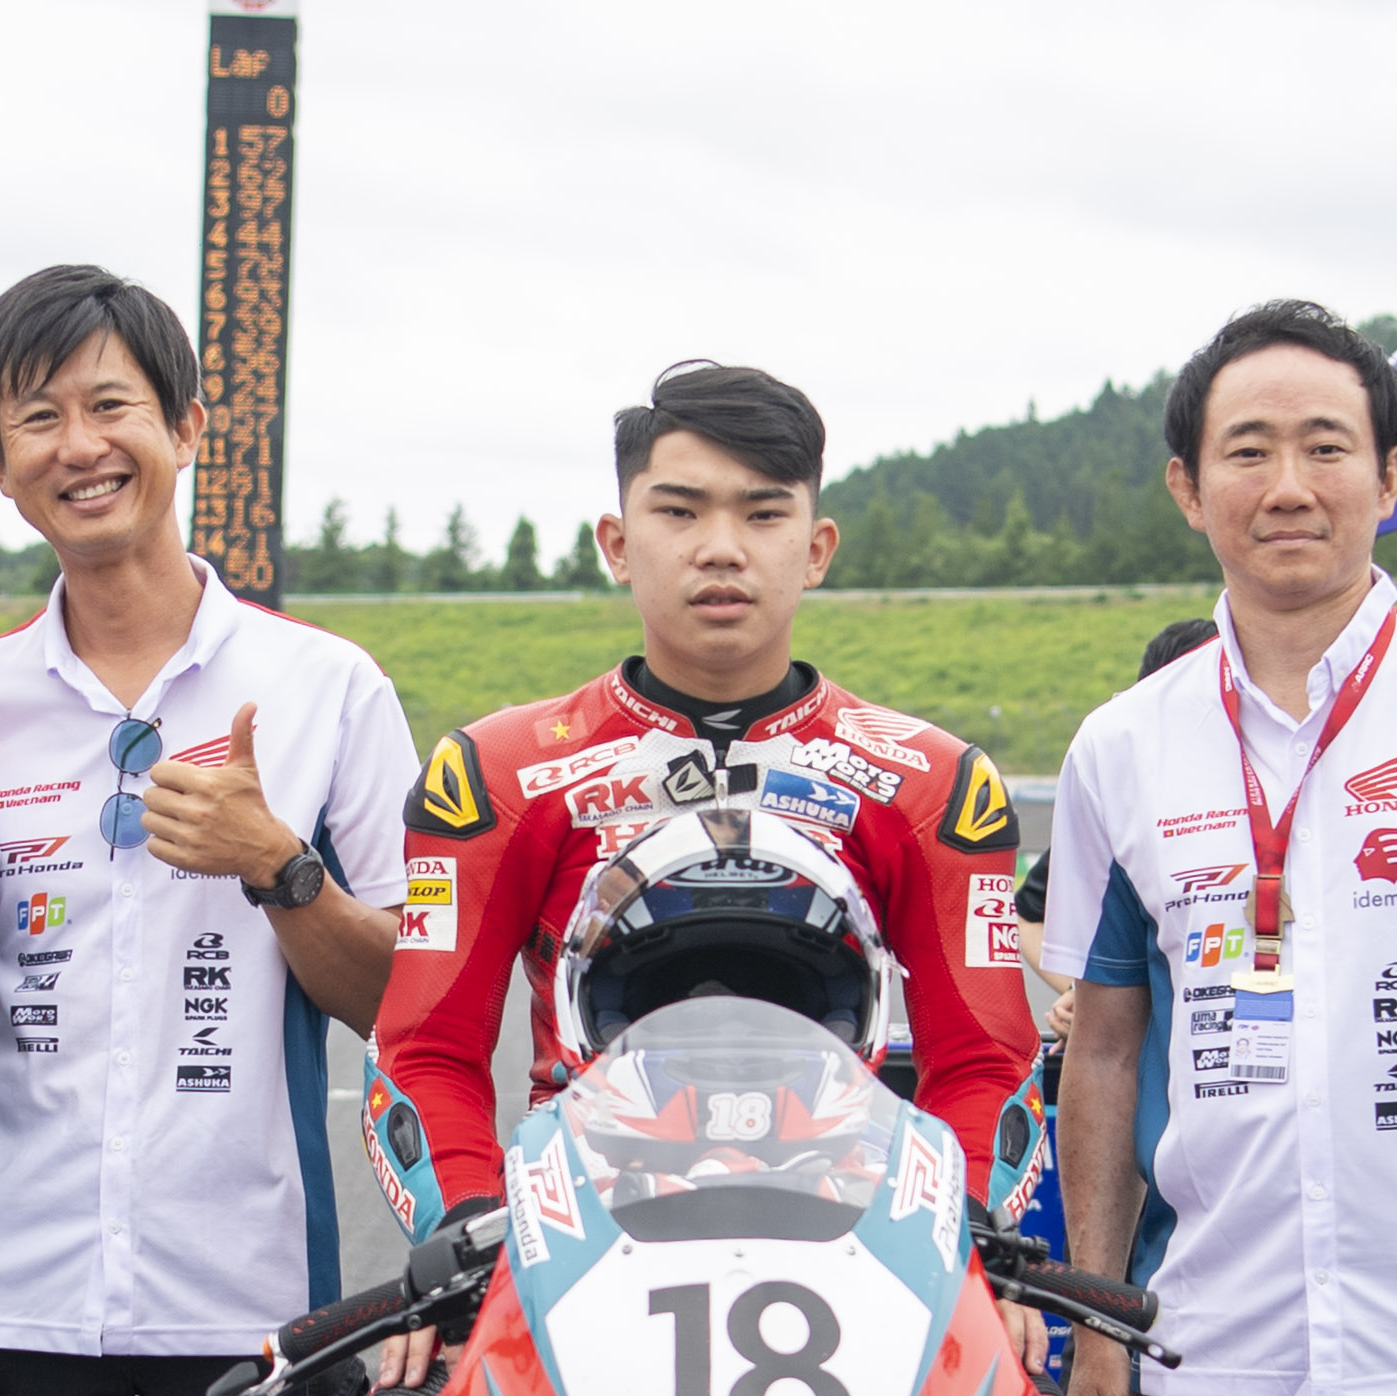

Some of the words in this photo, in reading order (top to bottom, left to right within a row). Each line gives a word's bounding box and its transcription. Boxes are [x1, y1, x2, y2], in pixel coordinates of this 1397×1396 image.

[611, 676, 677, 731] TAICHI
[836, 723, 926, 769] HONDA
[570, 742, 636, 774] RCB
[33, 780, 82, 793] Racing
[6, 793, 62, 808] Vietnam
[573, 775, 652, 816] RK
[762, 794, 850, 827] ASHUKA
[1156, 813, 1203, 828] Honda
[1205, 807, 1250, 820] Racin
[1175, 820, 1237, 836] Vietnam
[18, 861, 84, 876] Honda
[406, 859, 449, 876] NDA
[407, 886, 446, 898] LOP
[1192, 889, 1250, 905] Hond
[993, 925, 1020, 950] NG
[186, 950, 230, 961] RCB
[183, 966, 232, 987] RK
[184, 997, 229, 1014] NGK
[177, 1047, 233, 1056] TAICHI
[177, 1077, 231, 1088] ASHUKA
[1194, 1080, 1249, 1099] PIRELLI
[705, 1091, 772, 1141] 18
